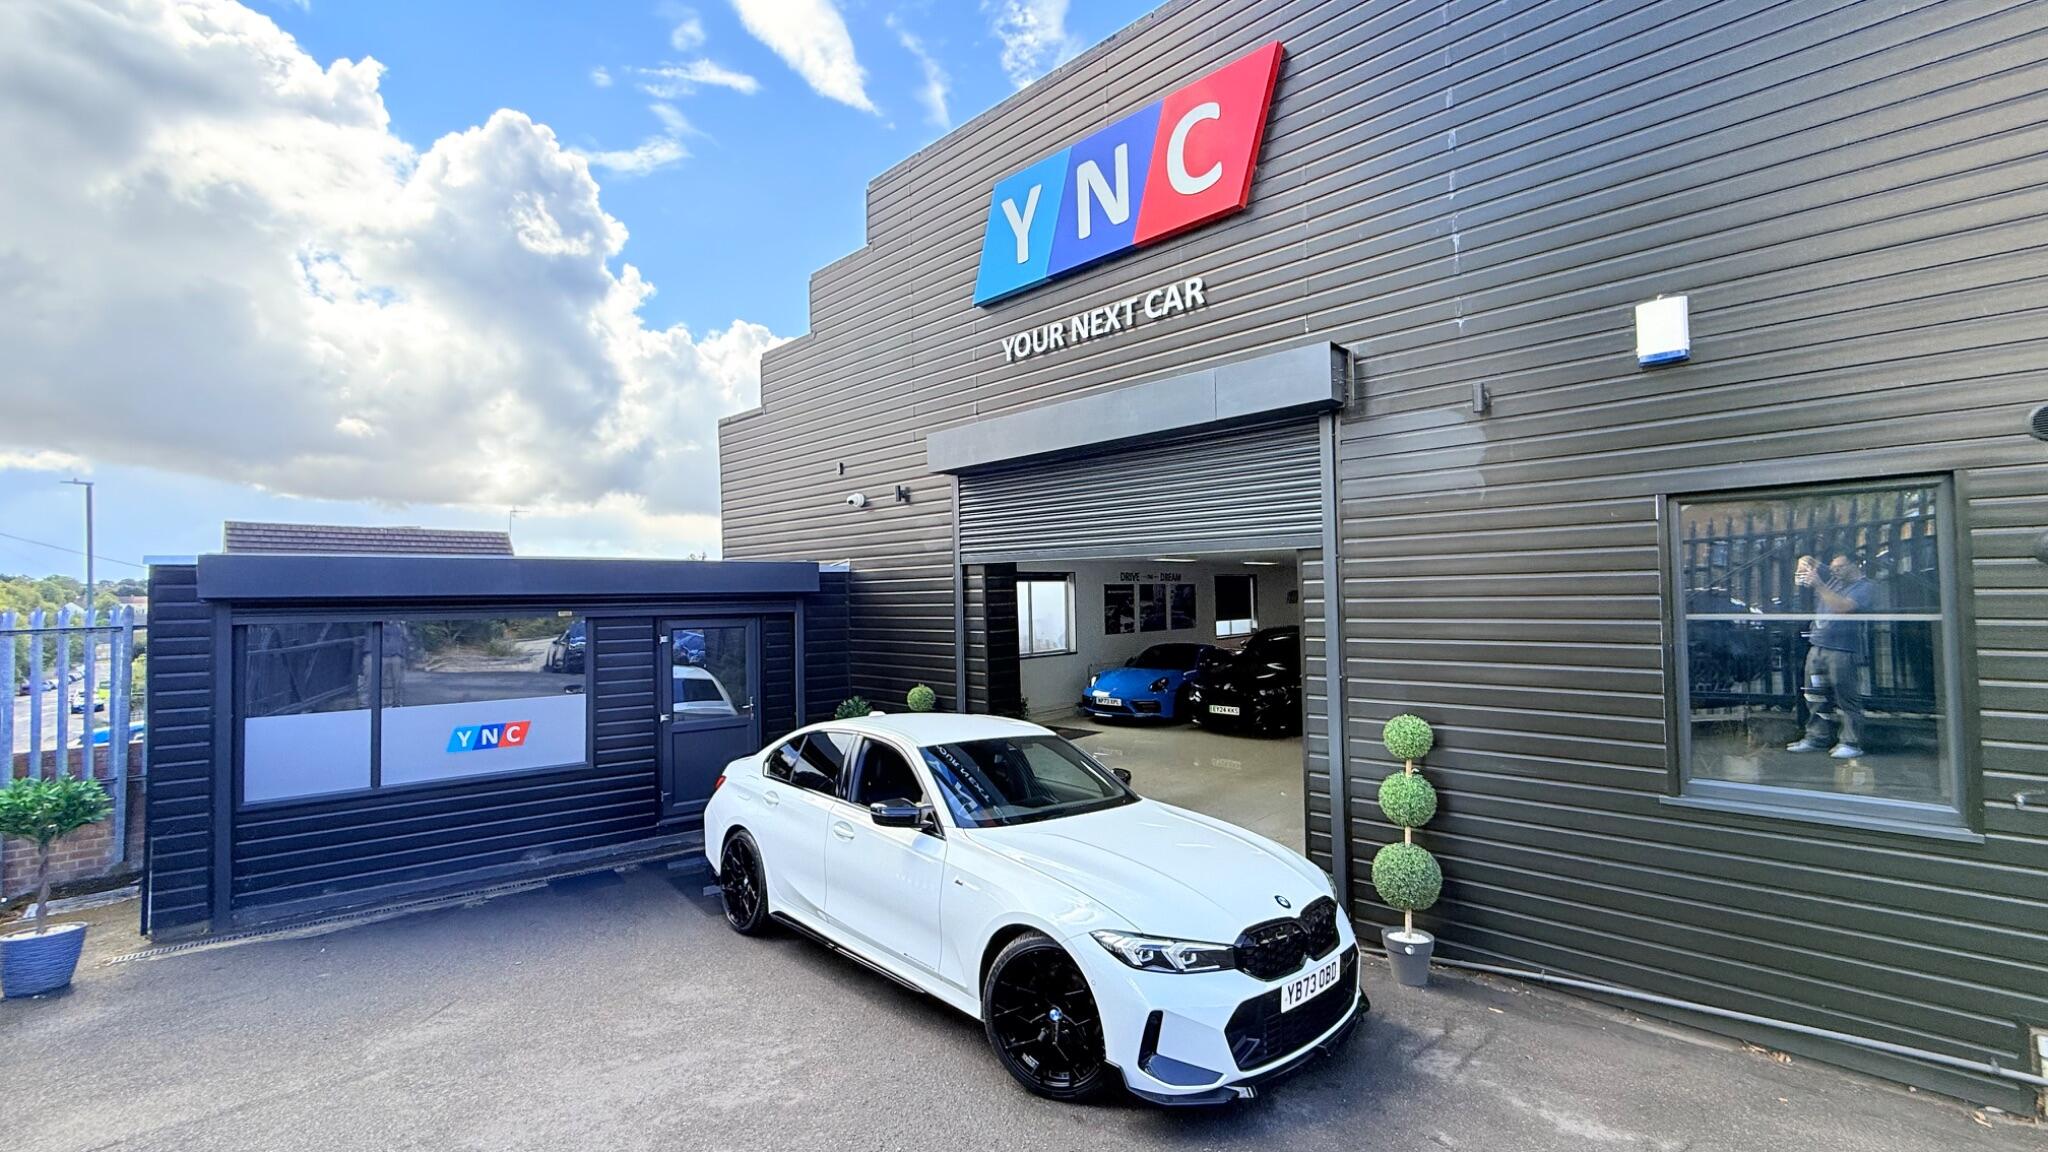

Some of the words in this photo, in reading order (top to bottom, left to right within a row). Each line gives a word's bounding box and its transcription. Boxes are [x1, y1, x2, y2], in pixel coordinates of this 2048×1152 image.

[1001, 102, 1222, 264] YNC
[1002, 323, 1064, 361] YOUR
[1071, 296, 1138, 342] NEXT
[1144, 277, 1205, 319] CAR
[1120, 572, 1140, 581] DRIVE
[1160, 572, 1182, 581] DREAM
[456, 726, 521, 748] YNC
[1288, 973, 1317, 1005] YB73
[1319, 961, 1337, 989] OBD
